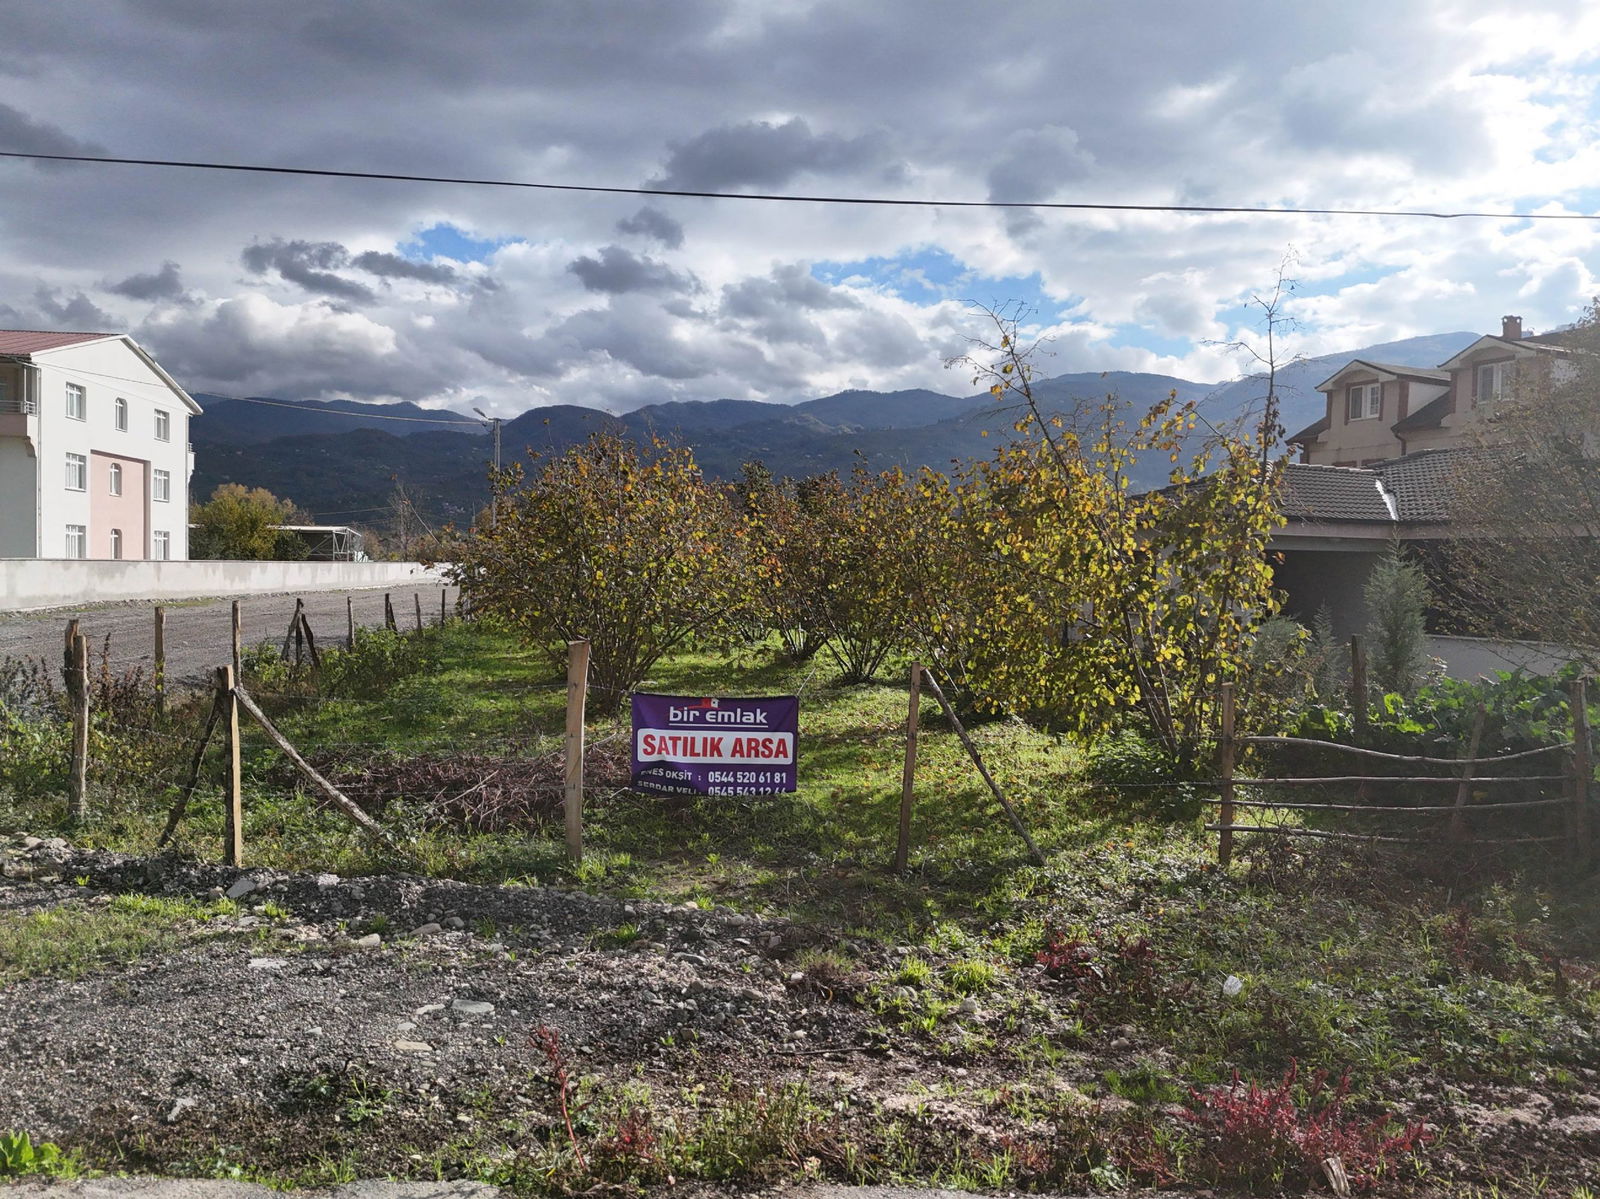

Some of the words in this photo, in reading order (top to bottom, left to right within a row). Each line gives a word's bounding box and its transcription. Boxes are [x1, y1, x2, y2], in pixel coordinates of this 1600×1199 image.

[669, 706, 699, 722] bir
[705, 708, 768, 724] emlak
[643, 734, 724, 758] SATILIK
[730, 737, 789, 759] ARSA
[708, 771, 735, 783] 0544
[736, 771, 756, 784] 520
[758, 772, 771, 784] 61
[774, 772, 787, 784] 81
[708, 786, 734, 796] 0545
